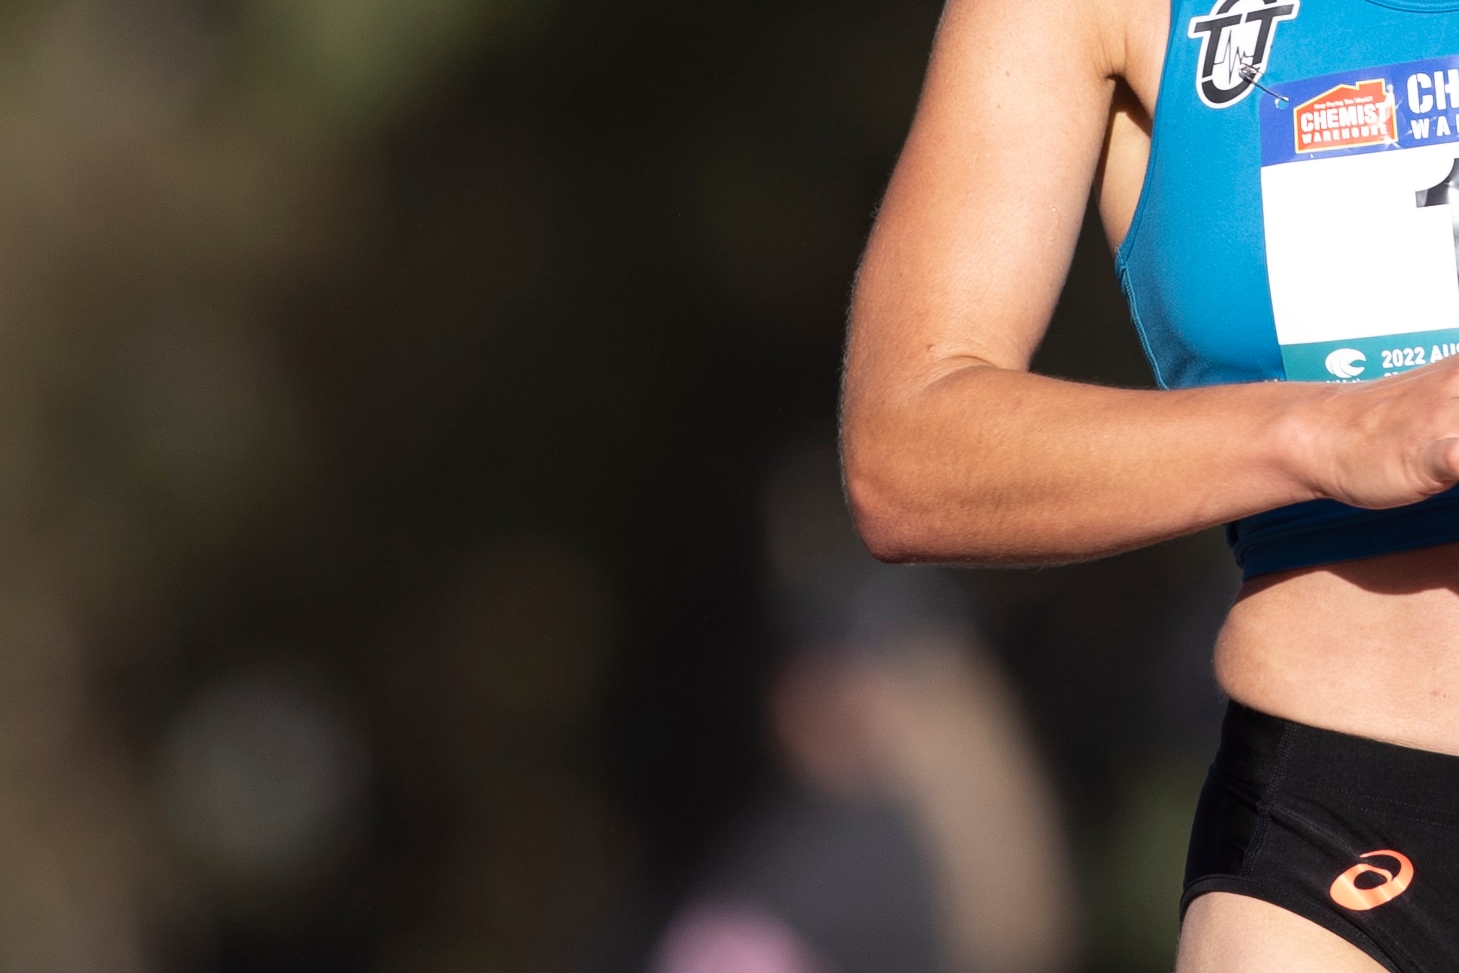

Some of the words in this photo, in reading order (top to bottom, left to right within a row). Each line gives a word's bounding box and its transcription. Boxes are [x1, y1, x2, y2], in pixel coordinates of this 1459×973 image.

[1300, 101, 1388, 132] CHEMIST
[1301, 123, 1388, 145] WAREHOUSE
[1381, 346, 1426, 369] 2022
